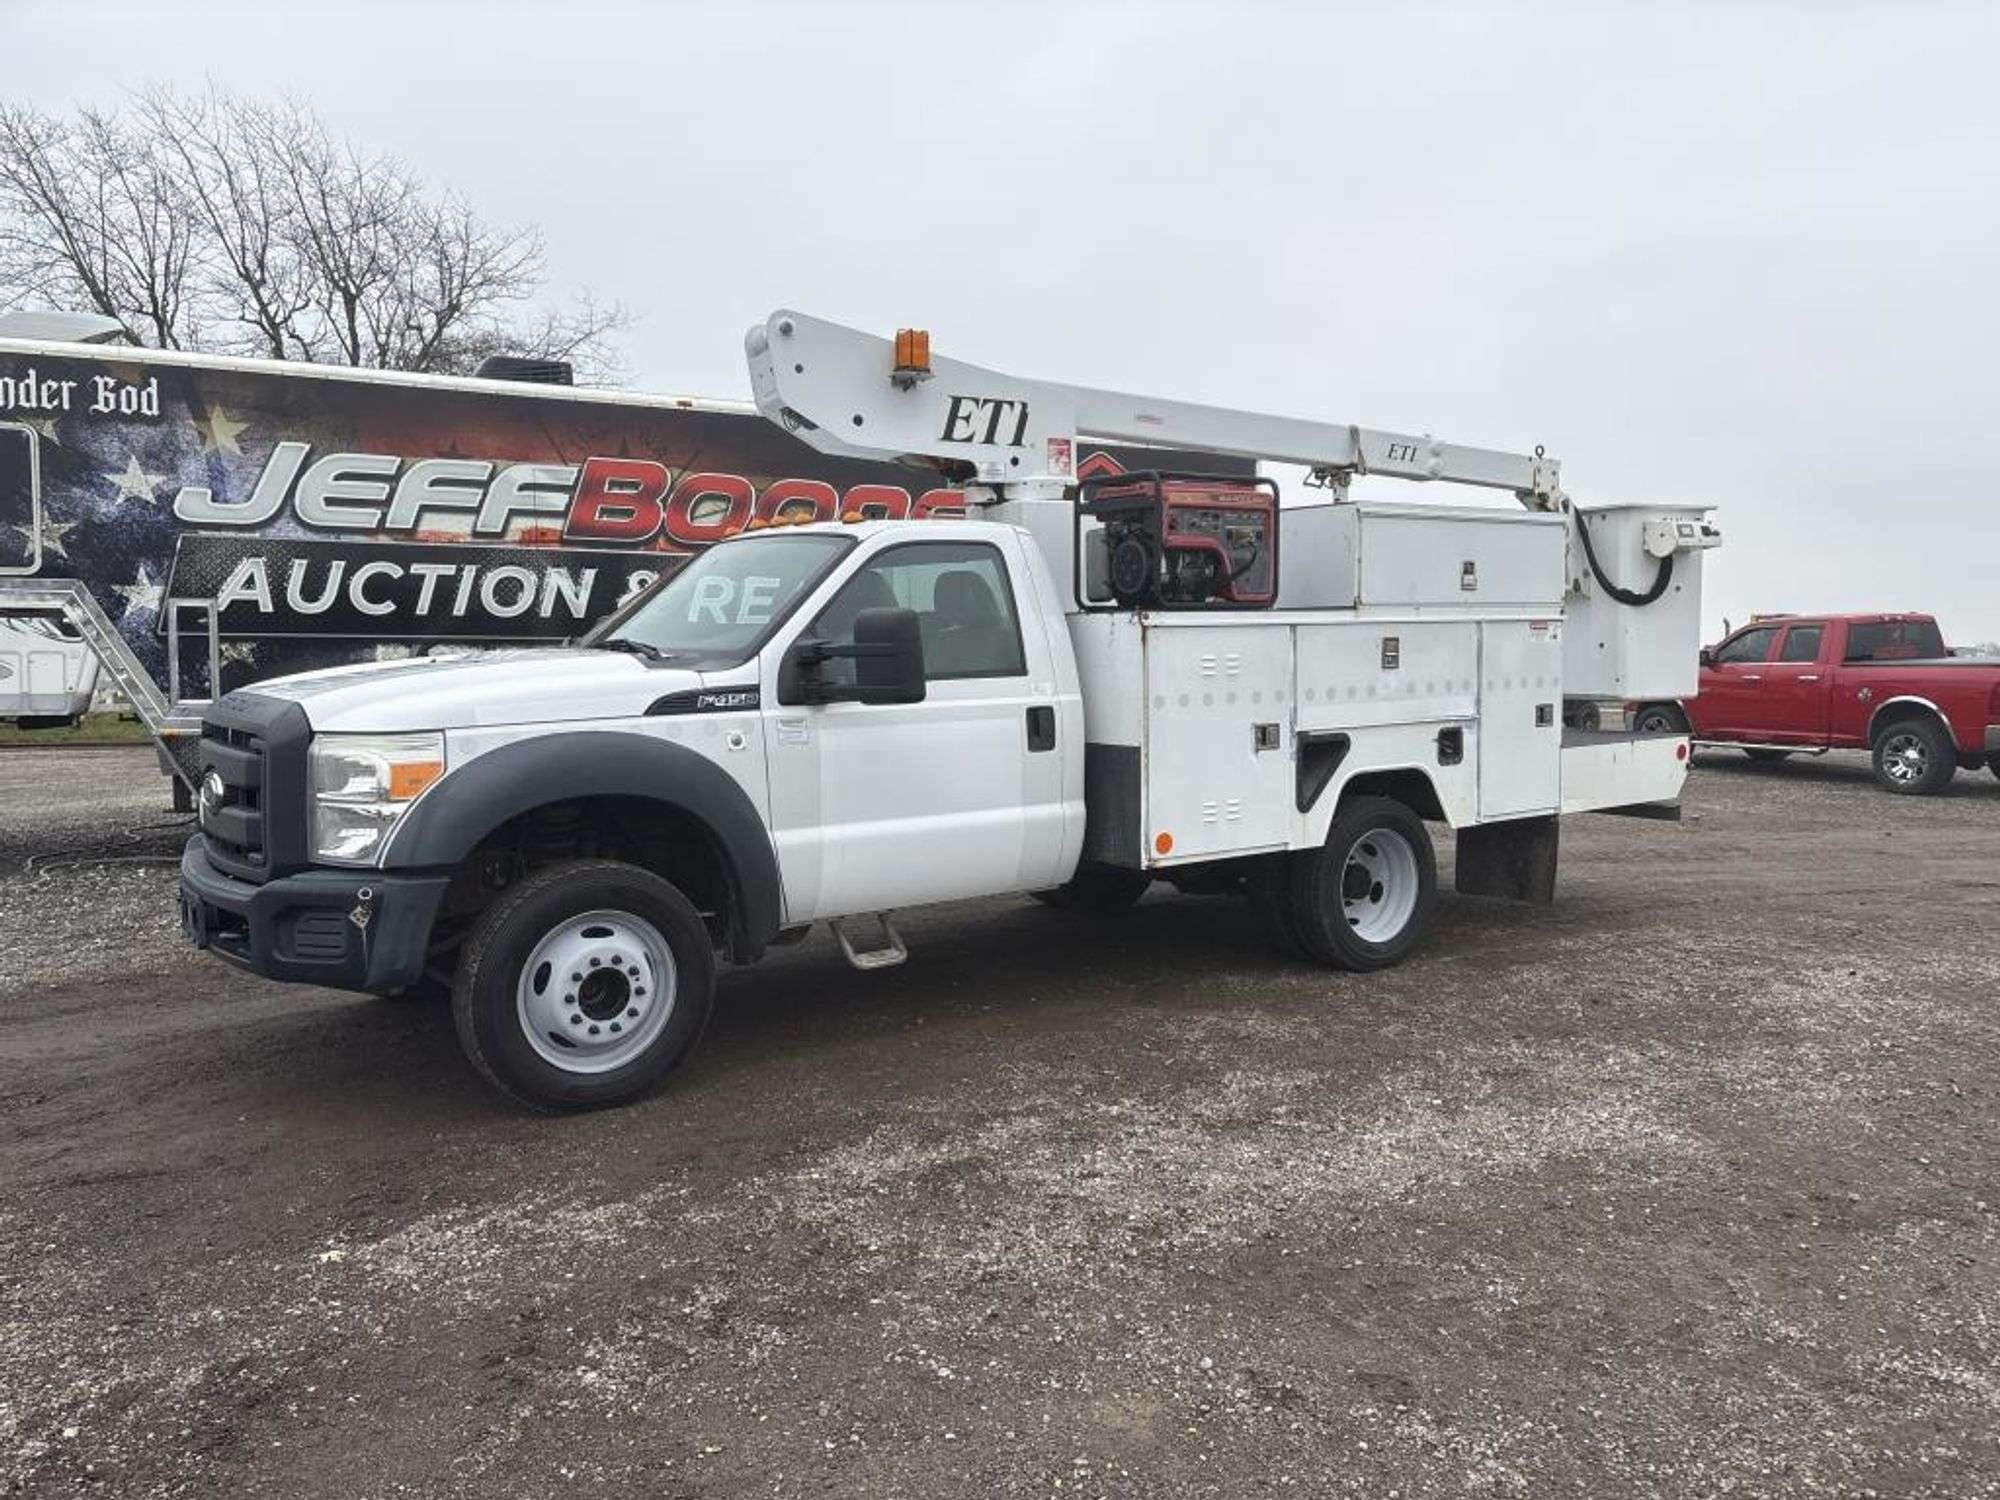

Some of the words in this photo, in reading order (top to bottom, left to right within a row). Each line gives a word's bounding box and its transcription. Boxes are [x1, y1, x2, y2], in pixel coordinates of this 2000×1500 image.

[939, 394, 1029, 448] ETI
[1388, 443, 1417, 463] ETI
[217, 556, 598, 619] AUCTION
